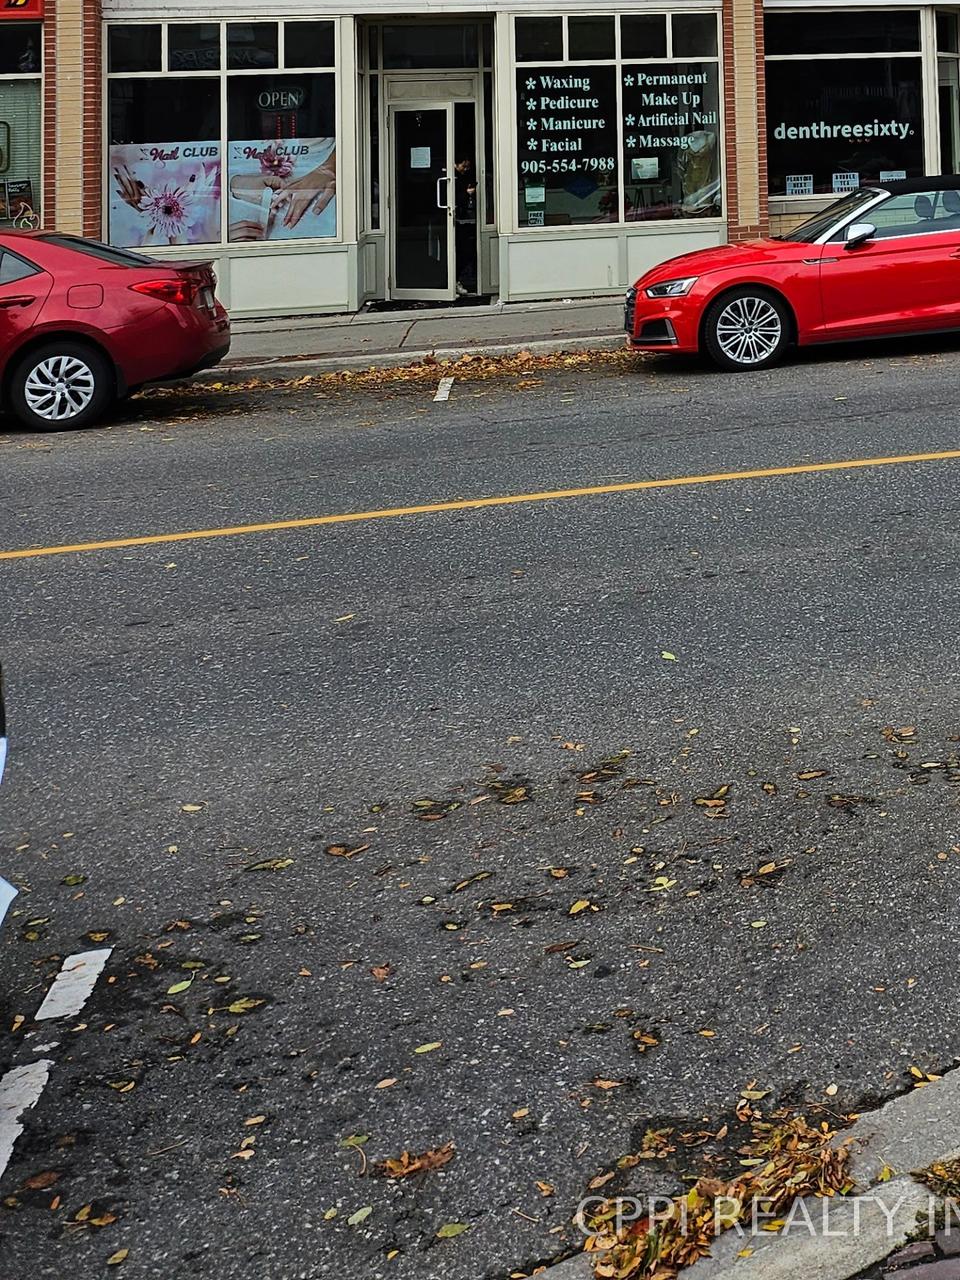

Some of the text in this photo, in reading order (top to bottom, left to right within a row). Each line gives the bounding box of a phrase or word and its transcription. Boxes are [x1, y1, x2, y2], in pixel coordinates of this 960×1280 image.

[540, 76, 591, 91] Waxing
[637, 72, 708, 86] Permanent
[258, 90, 300, 107] OPEN
[540, 96, 599, 110] Pedicure
[641, 91, 701, 108] Make Up
[541, 116, 606, 131] Manicure
[637, 111, 717, 127] Artificial Nail
[774, 119, 915, 140] denthreesixty.
[541, 138, 582, 152] Facial
[639, 134, 695, 150] Massage
[183, 146, 218, 158] CLUB
[275, 145, 310, 156] CLUB
[521, 157, 615, 174] 905-554-7988
